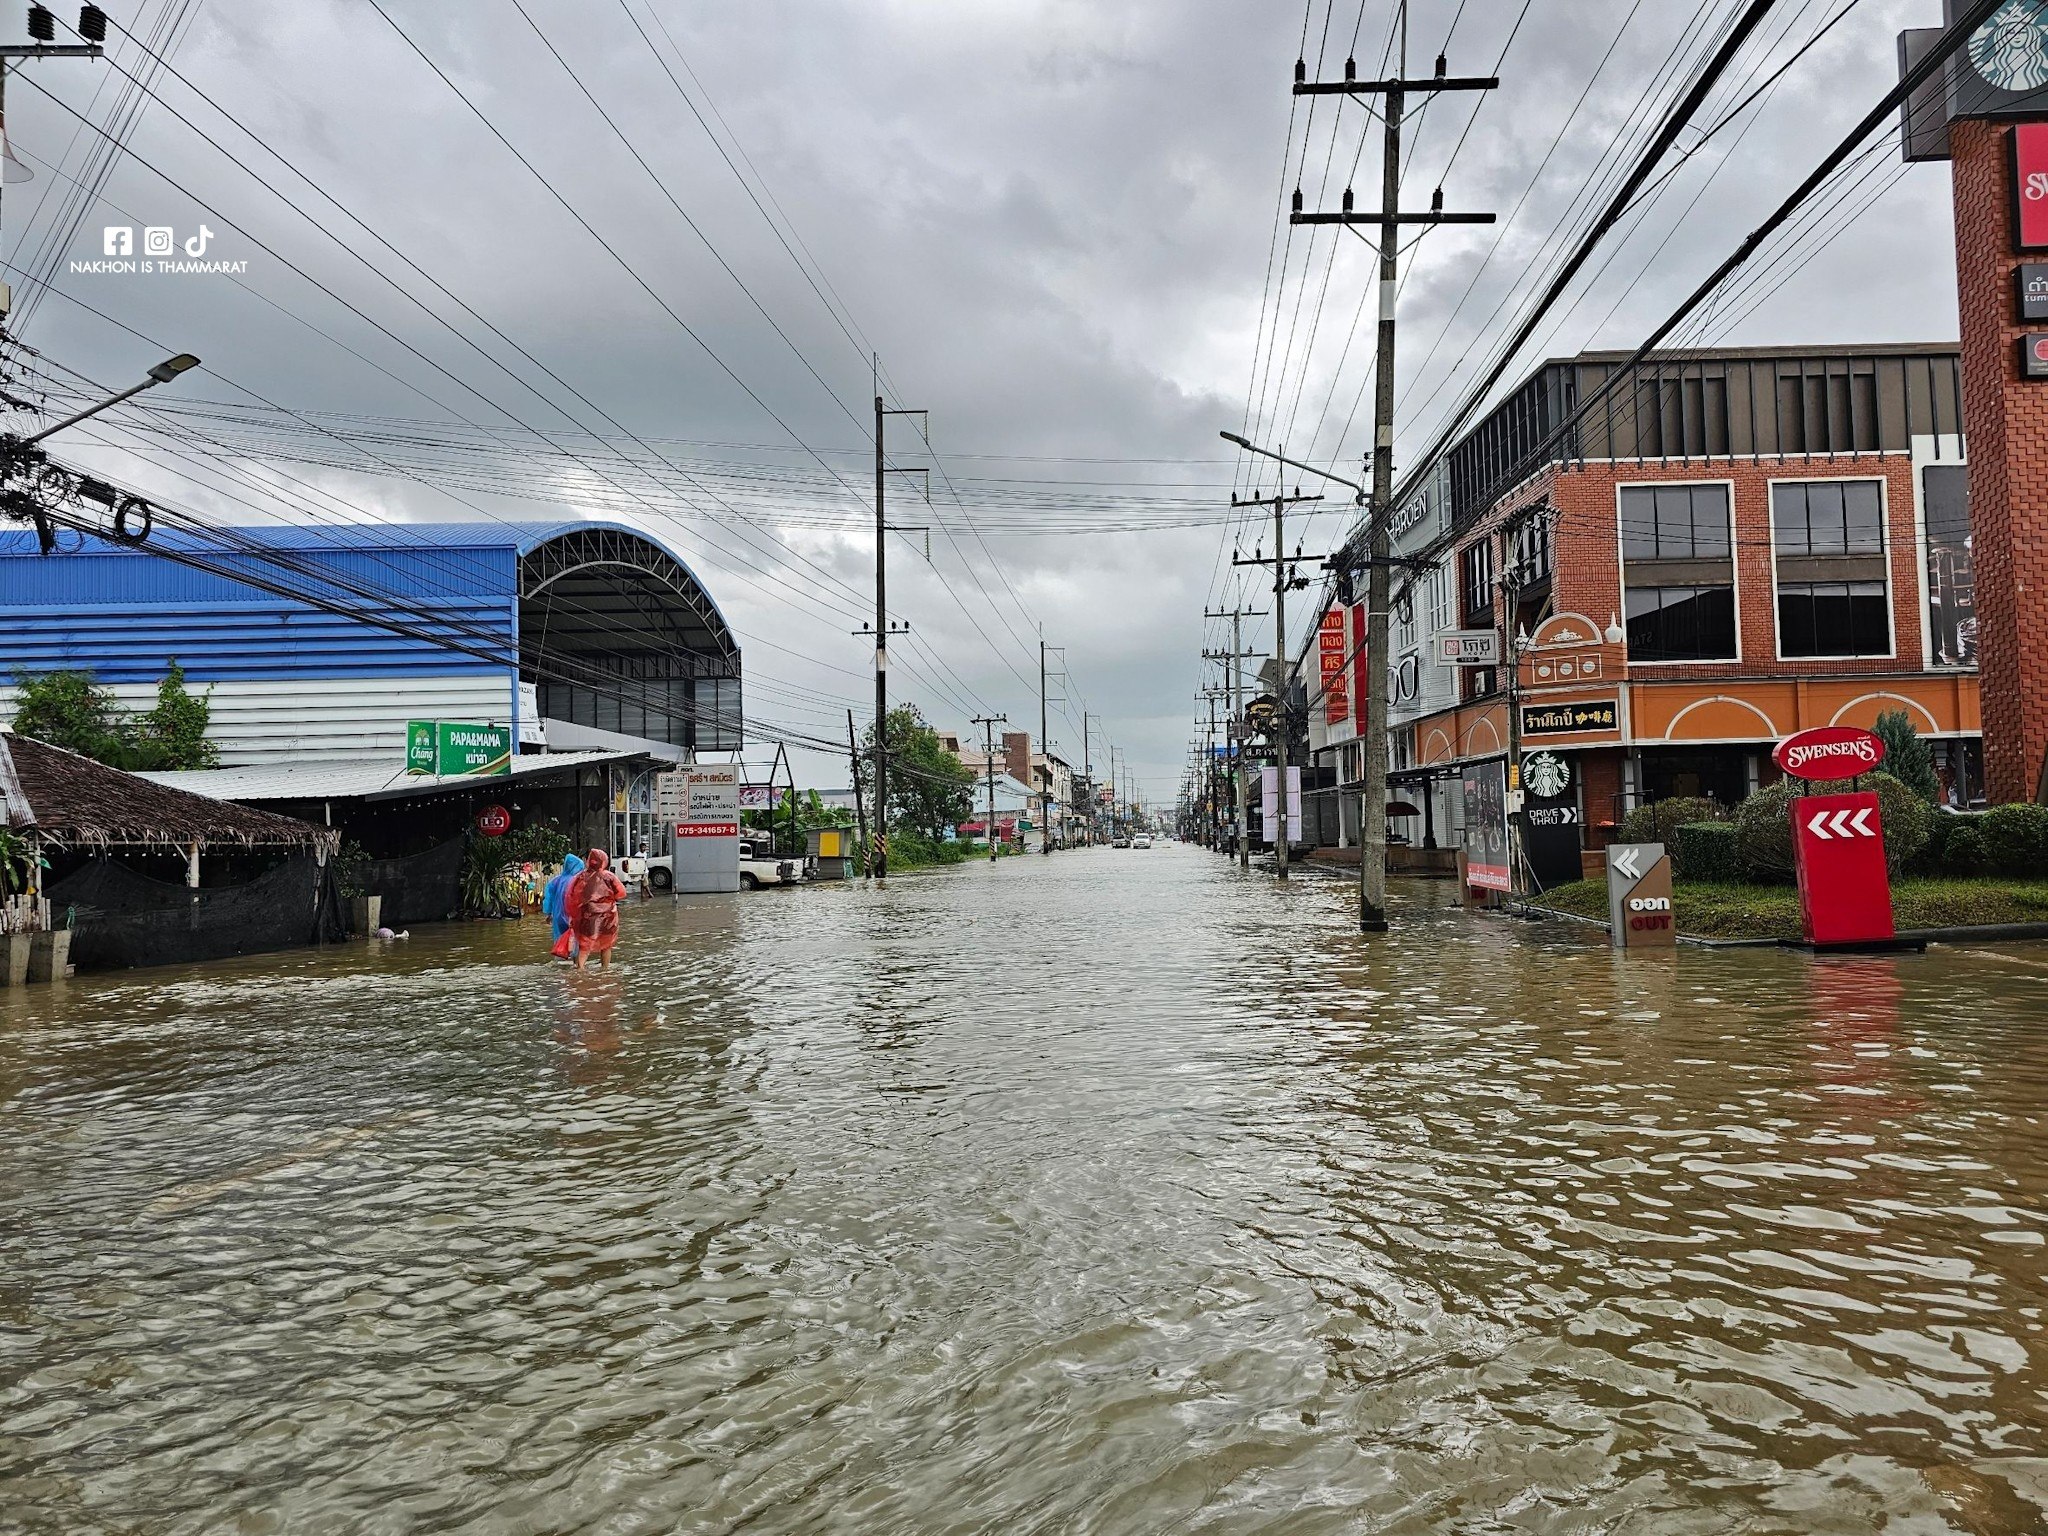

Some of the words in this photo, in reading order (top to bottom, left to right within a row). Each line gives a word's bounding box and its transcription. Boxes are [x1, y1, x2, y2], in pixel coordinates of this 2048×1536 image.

[2024, 294, 2048, 302] tum
[1388, 491, 1428, 540] HAROEN
[1321, 636, 1343, 647] ทอง
[450, 731, 501, 747] PAPA&MAMA
[410, 746, 434, 762] Chang
[1787, 740, 1875, 768] SWENSEN'S
[1529, 808, 1559, 819] DRIVE
[481, 816, 504, 828] LEO
[1531, 816, 1558, 826] THRU
[679, 826, 736, 835] 075-341657-8
[1629, 897, 1671, 911] ออก
[1631, 915, 1672, 931] OUT
